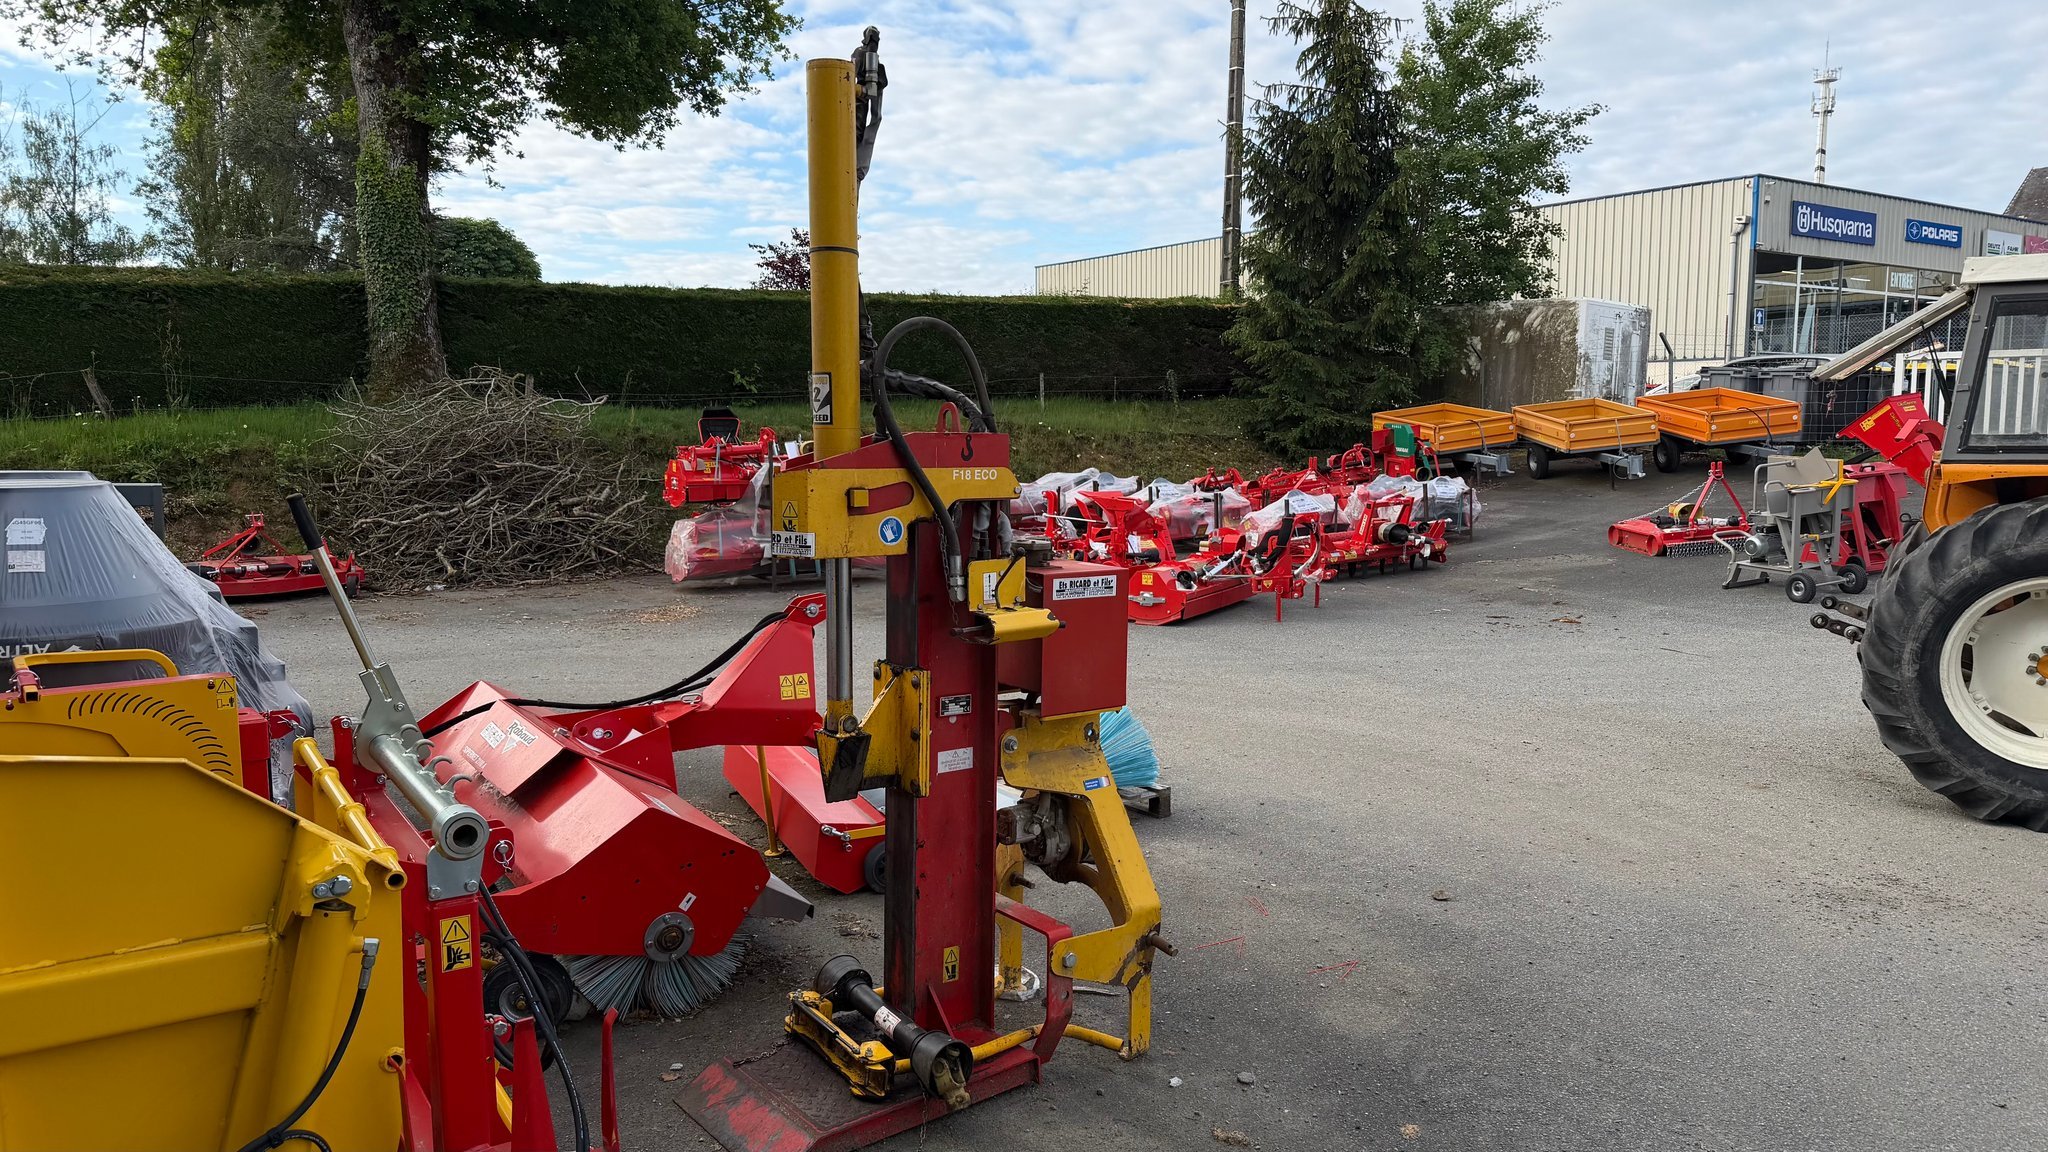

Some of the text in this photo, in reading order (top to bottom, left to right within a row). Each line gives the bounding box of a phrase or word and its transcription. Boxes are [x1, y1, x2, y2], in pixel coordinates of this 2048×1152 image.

[1811, 210, 1872, 238] Husqvarna
[1921, 226, 1959, 242] POLARIS
[1988, 242, 2001, 250] DEUTZ
[813, 386, 821, 403] 2
[952, 469, 998, 480] F18 ECO
[784, 535, 792, 544] et
[794, 534, 808, 545] Fils
[1058, 581, 1068, 590] Ets
[1069, 579, 1092, 589] RICARD
[1092, 579, 1100, 587] et
[508, 721, 537, 745] Rabaud
